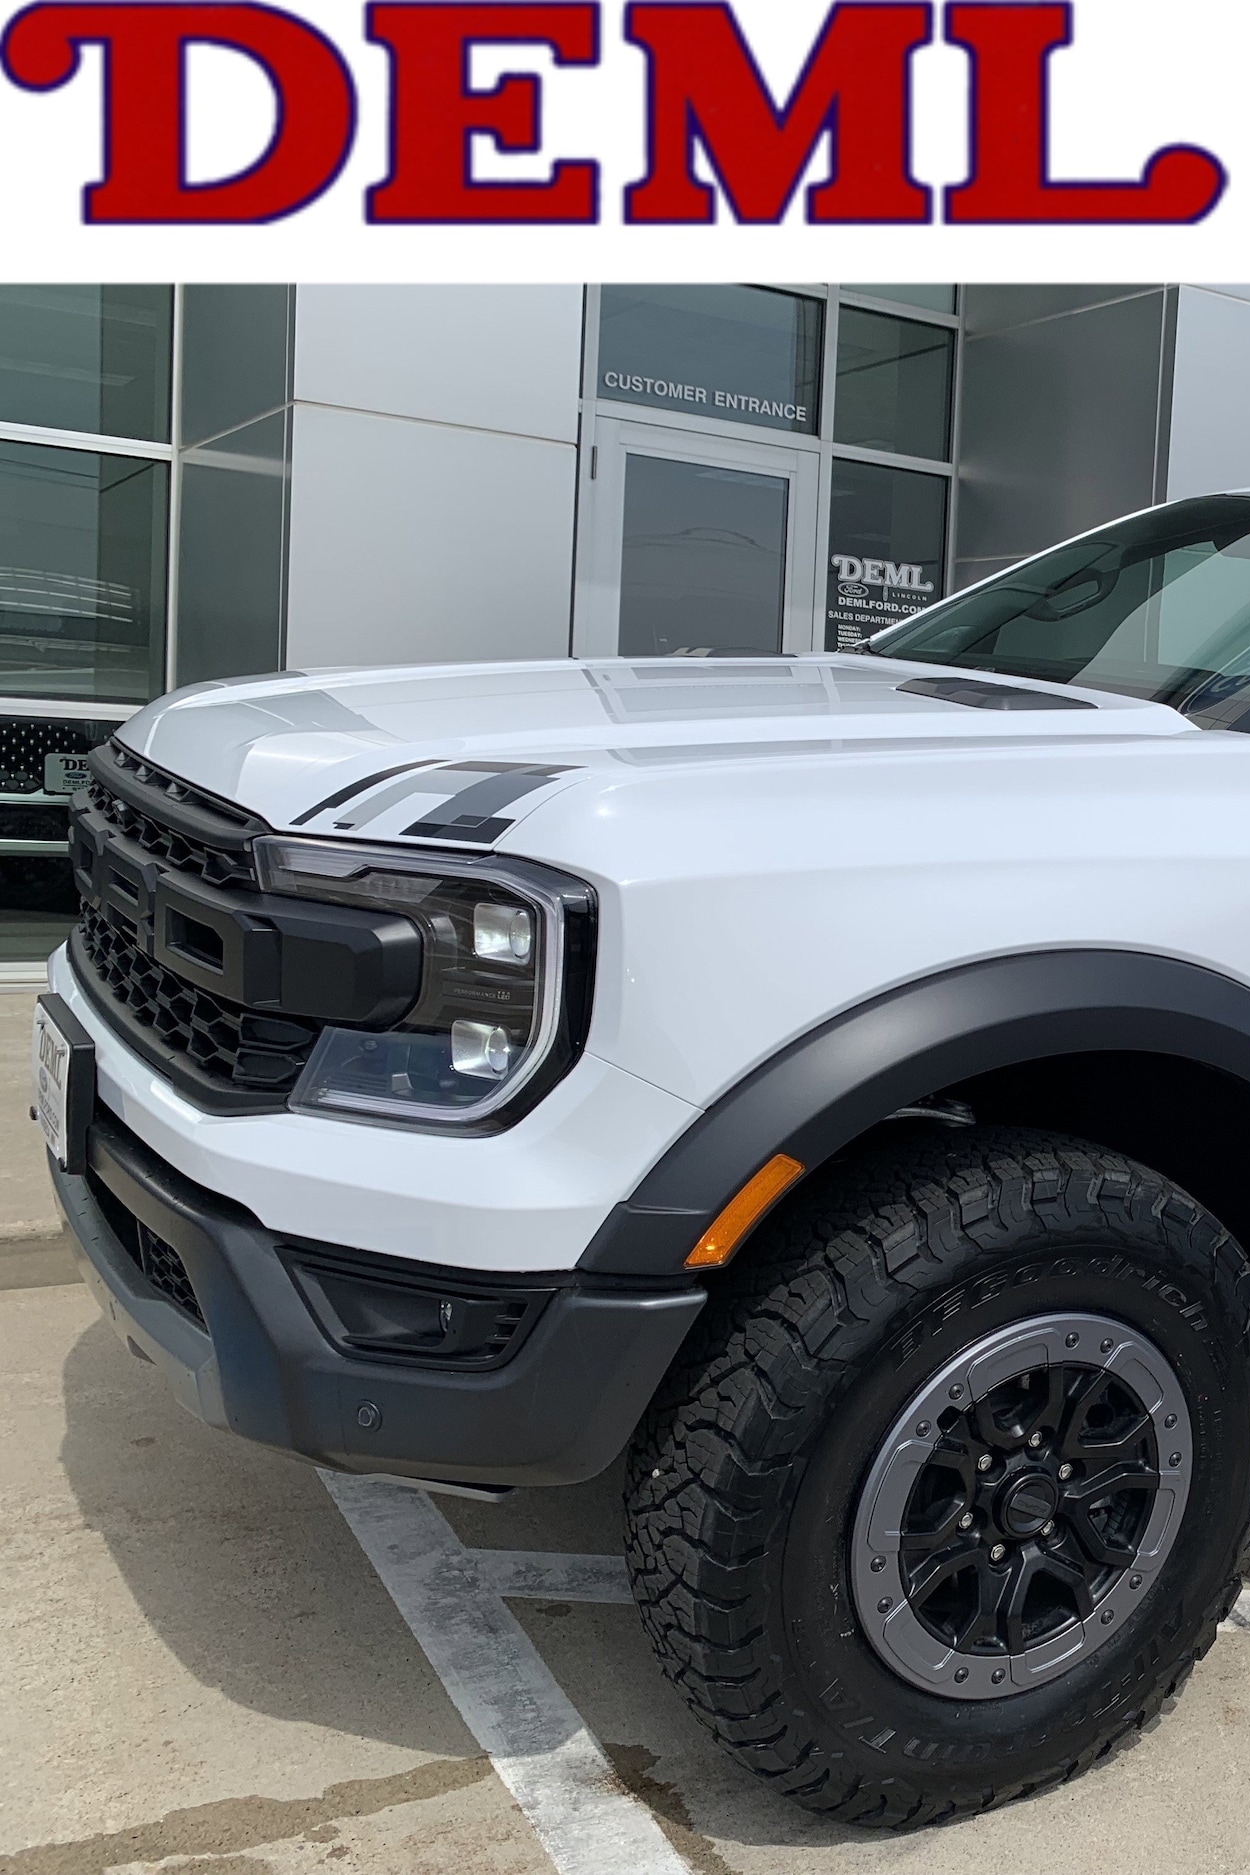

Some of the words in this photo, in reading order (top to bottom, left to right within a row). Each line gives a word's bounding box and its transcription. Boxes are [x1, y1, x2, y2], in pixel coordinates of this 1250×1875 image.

[603, 371, 707, 404] CUSTOMER
[714, 390, 807, 422] ENTRANCE
[831, 554, 934, 592] DEML
[892, 592, 927, 602] LINCOLN
[828, 610, 854, 621] SALES
